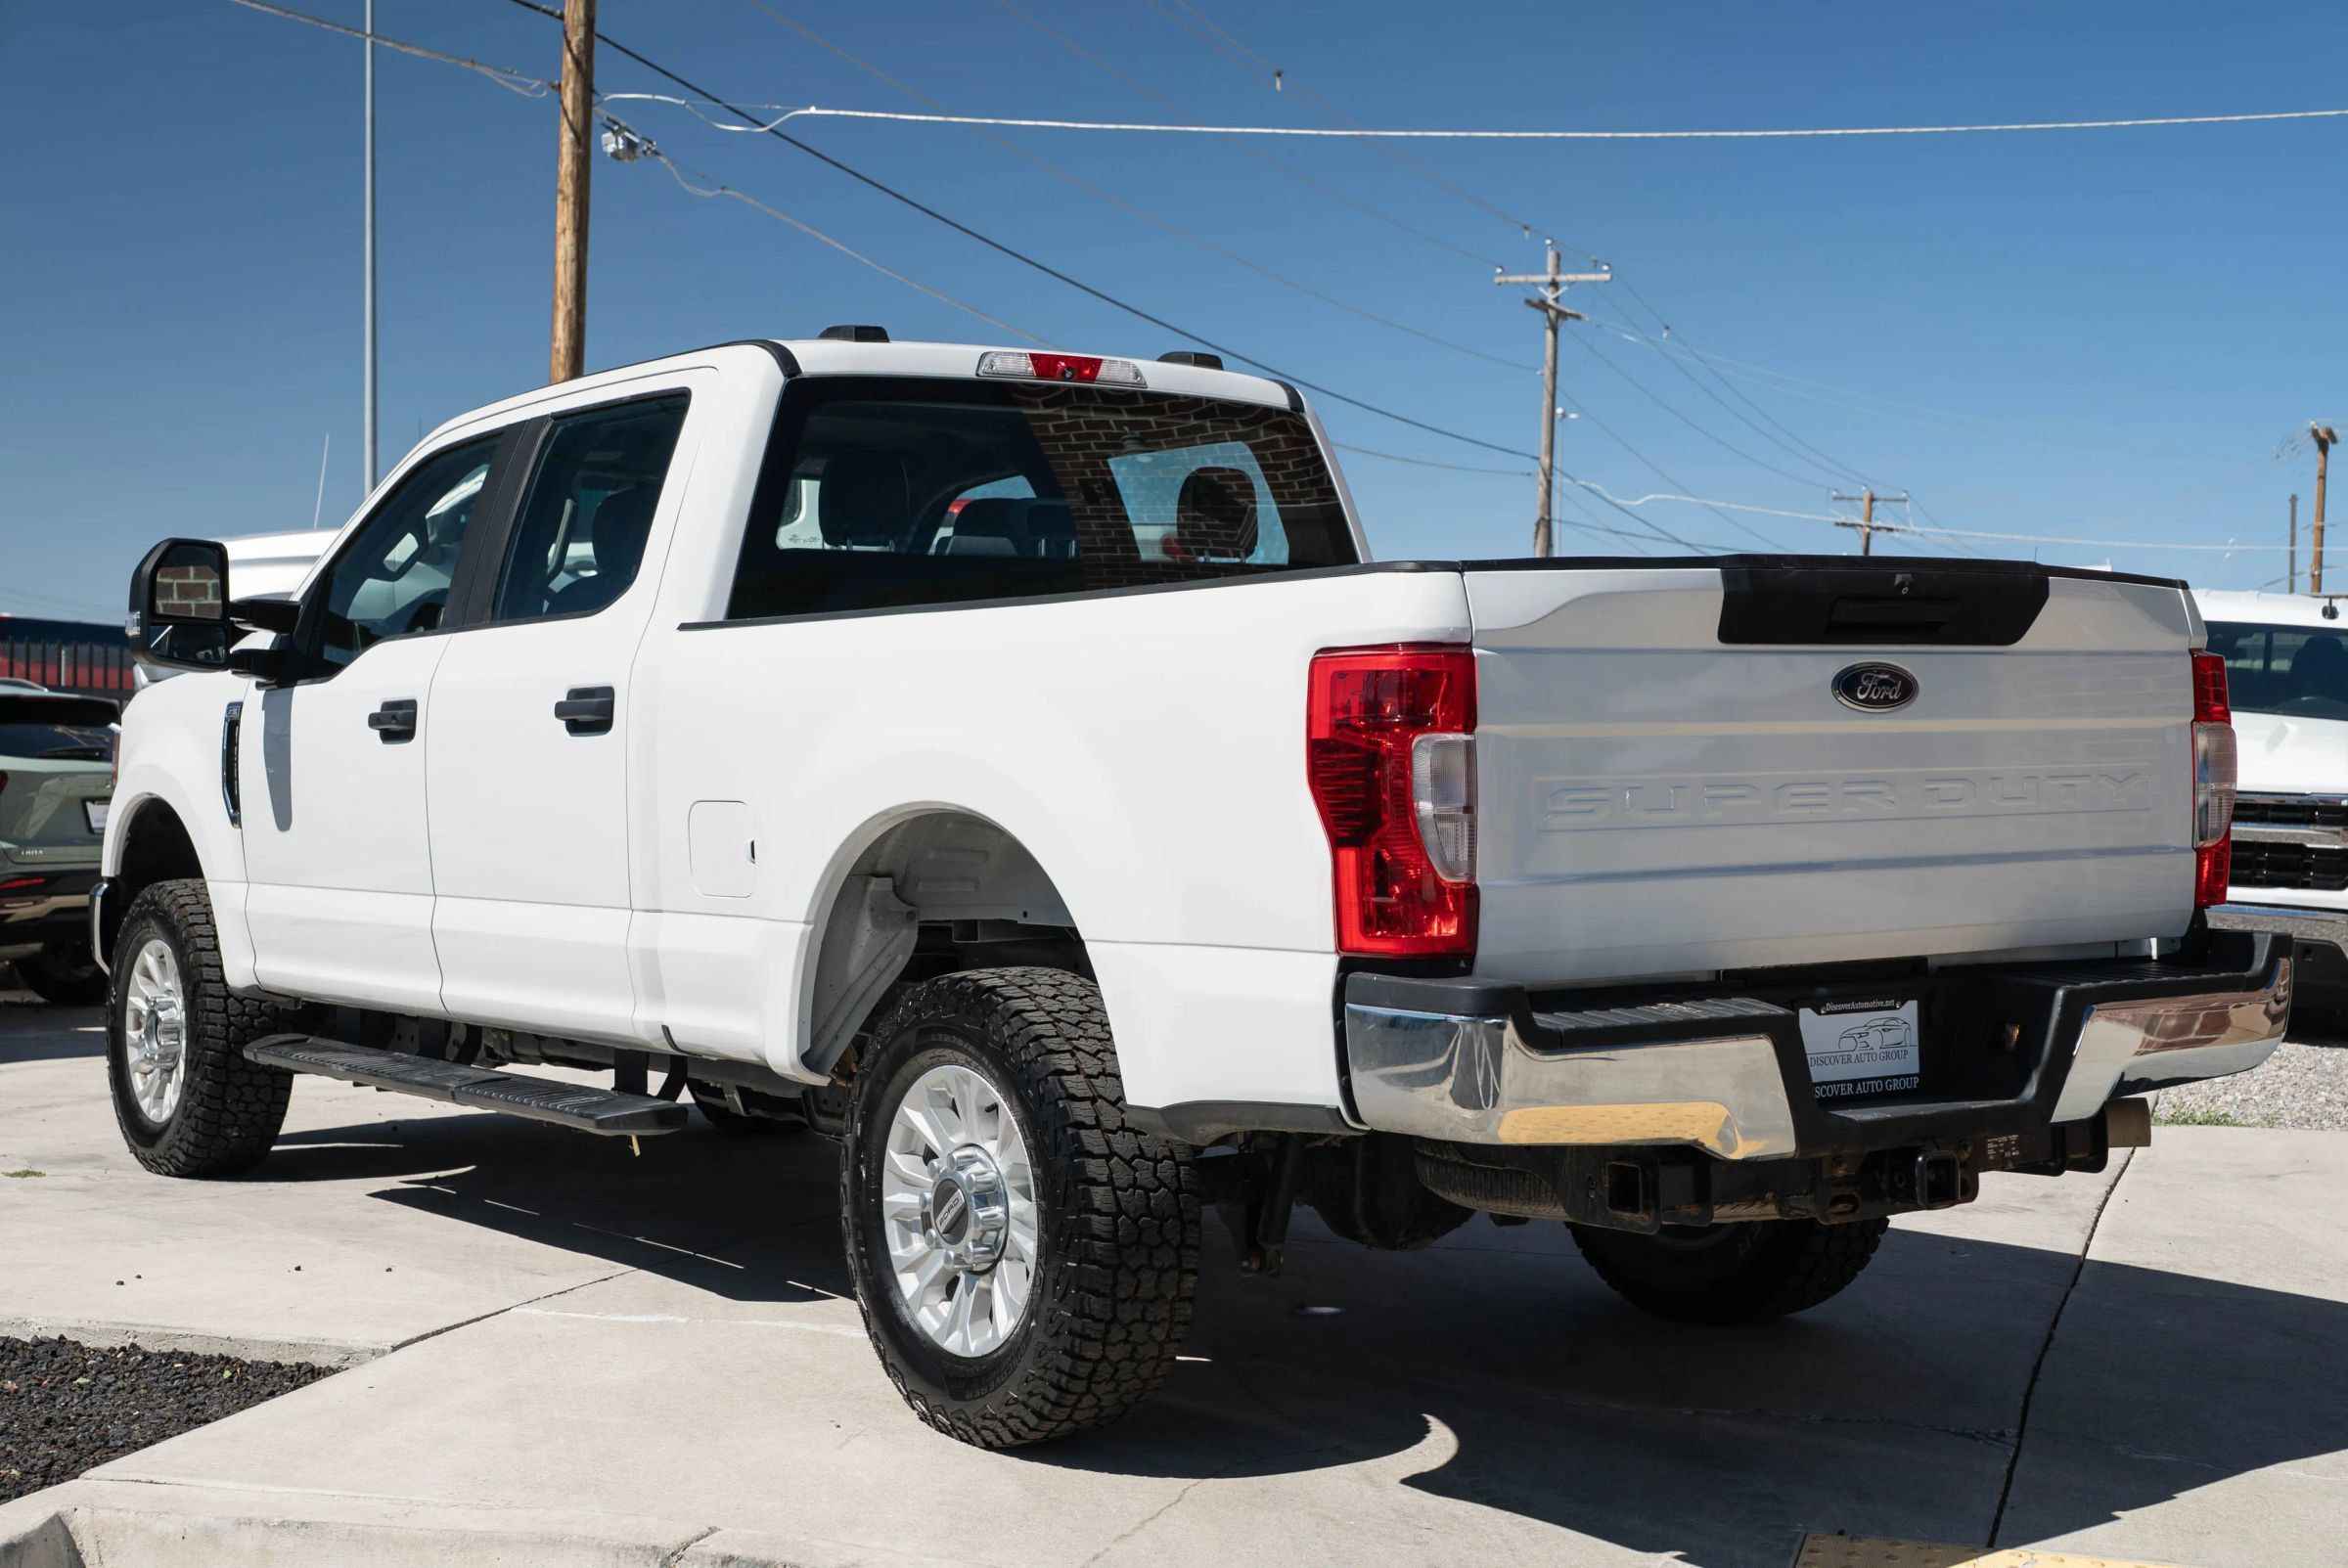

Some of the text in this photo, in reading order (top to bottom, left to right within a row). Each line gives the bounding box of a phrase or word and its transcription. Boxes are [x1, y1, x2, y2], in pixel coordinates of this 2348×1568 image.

[1857, 673, 1902, 699] Ford
[1544, 772, 2145, 824] SUPER DUTY
[1826, 999, 1895, 1011] DiscoverAutomotive.net
[1810, 1049, 1909, 1067] DISCOVER AUTO GROUP
[1815, 1076, 1919, 1098] SCOVER AUTO GROUP
[939, 1197, 960, 1227] FORD
